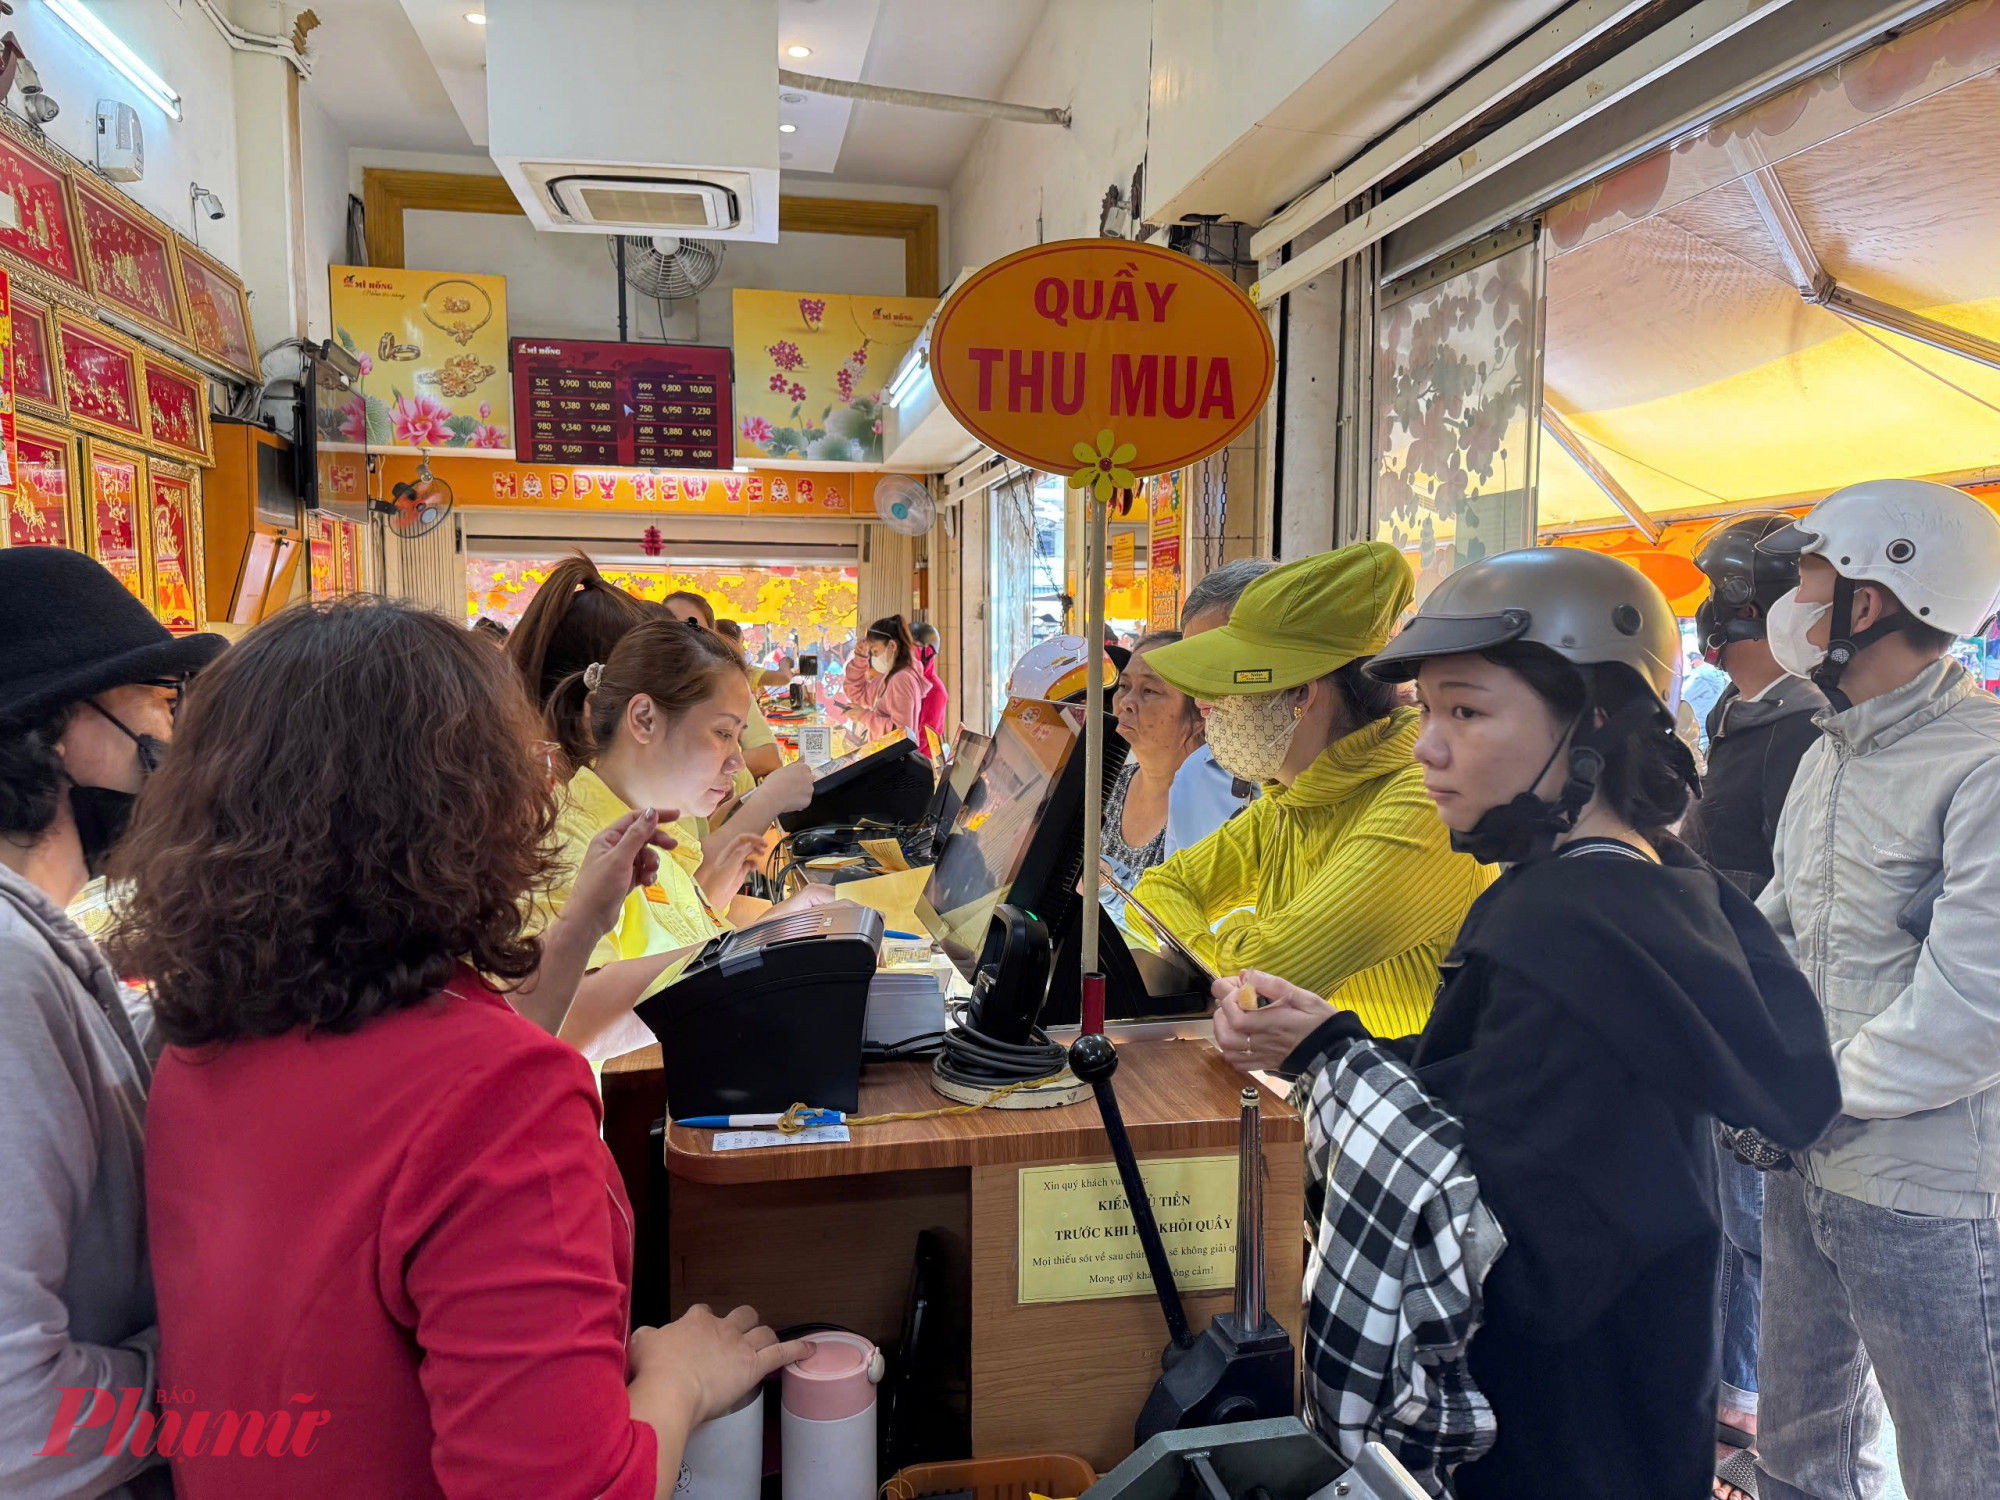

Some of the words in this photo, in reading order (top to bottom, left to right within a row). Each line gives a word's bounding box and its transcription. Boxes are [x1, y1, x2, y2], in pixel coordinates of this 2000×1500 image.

[1034, 262, 1178, 327] QUẦY
[559, 379, 580, 388] 9,900
[588, 381, 612, 389] 10,000
[661, 384, 681, 392] 9,800
[689, 385, 713, 394] 10,000
[968, 348, 1086, 416] THU
[1109, 353, 1236, 420] MUA
[560, 401, 581, 410] 9,380
[590, 403, 610, 411] 9,680
[639, 405, 653, 413] 750
[662, 406, 682, 415] 6,950
[691, 407, 711, 416] 7,230
[537, 422, 551, 430] 980
[561, 423, 581, 432] 9,340
[591, 425, 611, 433] 9,640
[639, 426, 653, 434] 680
[663, 427, 683, 436] 5,880
[692, 429, 712, 438] 6,160
[538, 444, 552, 452] 950
[562, 445, 582, 454] 9,050
[599, 446, 605, 454] 0
[640, 448, 654, 456] 610
[663, 449, 683, 458] 5,780
[692, 450, 713, 459] 6,060
[493, 472, 617, 499] HAPPY
[629, 473, 708, 502] NEW
[724, 476, 814, 503] YEAR
[1043, 1181, 1060, 1191] Xin
[1061, 1179, 1078, 1192] quý
[1081, 1177, 1107, 1188] khách
[1159, 1190, 1191, 1207] TIỀN
[1055, 1225, 1101, 1241] TRƯỚC
[1104, 1225, 1128, 1238] KHI
[1159, 1218, 1192, 1233] KHỎI
[1195, 1214, 1233, 1232] QUẦY
[1032, 1256, 1051, 1268] Mọi
[1053, 1252, 1077, 1265] thiếu
[1079, 1254, 1092, 1264] sót
[1108, 1253, 1124, 1261] sau
[1168, 1246, 1178, 1256] sẽ
[1181, 1246, 1208, 1256] không
[1210, 1243, 1227, 1256] giải
[1089, 1274, 1115, 1285] Mong
[1117, 1273, 1134, 1284] quý
[1191, 1265, 1214, 1277] cảm!
